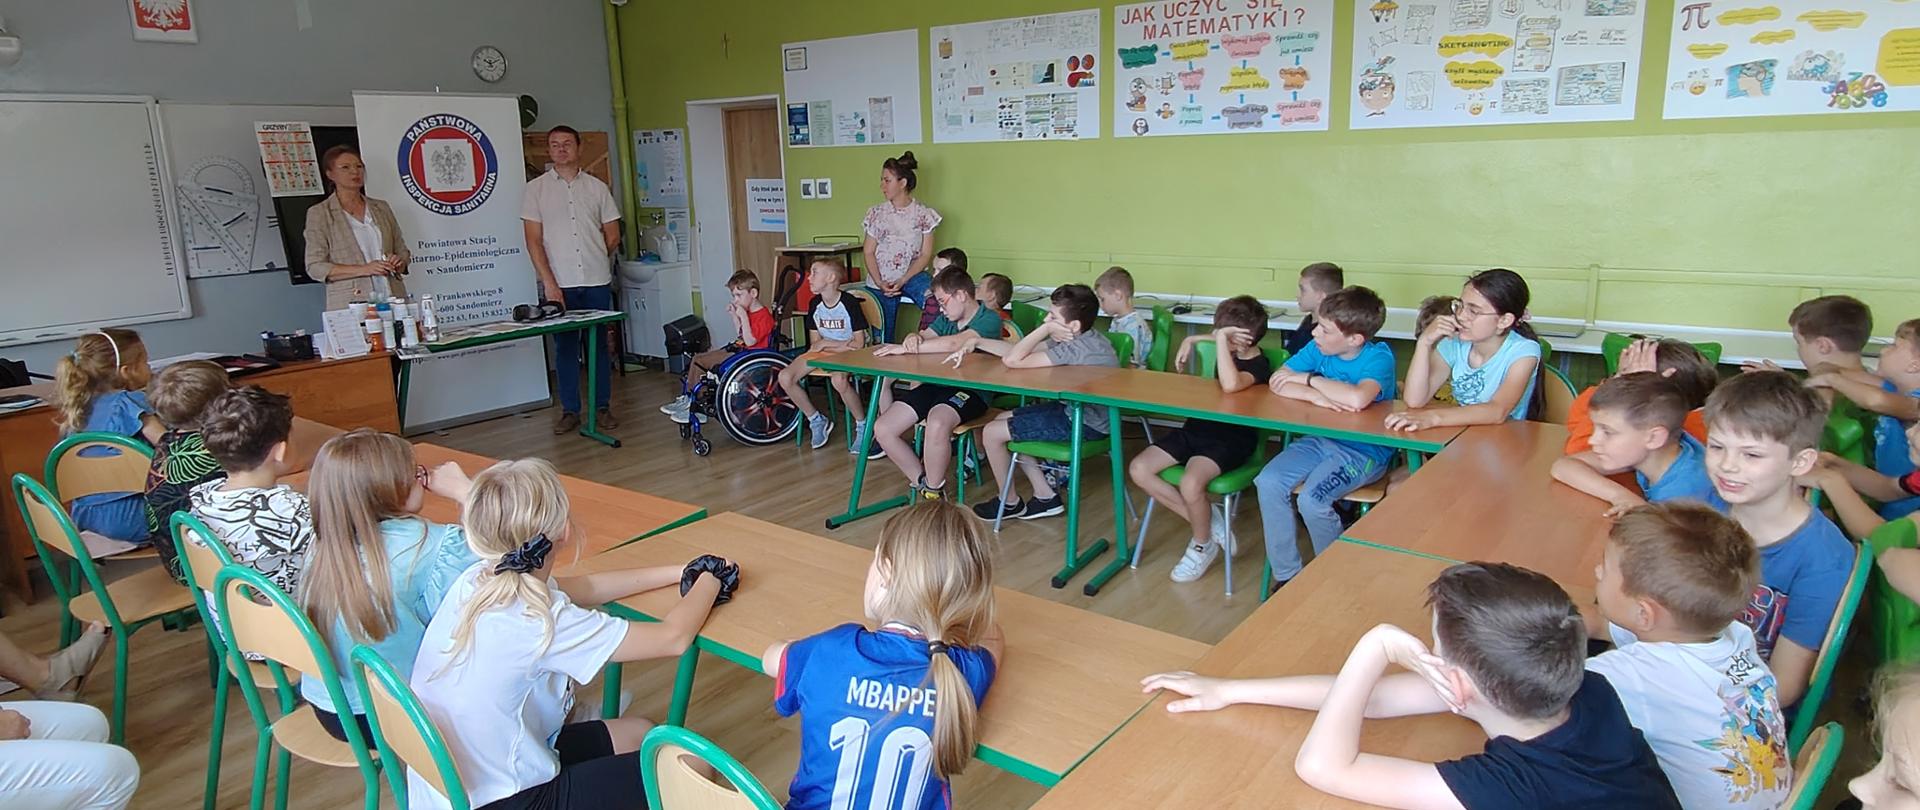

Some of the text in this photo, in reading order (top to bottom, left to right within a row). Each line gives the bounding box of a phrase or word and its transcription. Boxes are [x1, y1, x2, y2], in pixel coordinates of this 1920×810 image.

[1121, 6, 1155, 25] JAK
[407, 115, 483, 142] PAŃSTWOWA
[402, 172, 497, 214] INSPEKCJA SANITARNA
[418, 235, 497, 250] Powiatowa Stacja
[410, 246, 520, 264] itarno-Epidemiologiczna
[437, 262, 495, 275] Sandomierzu
[456, 299, 502, 311] Sandomierz
[822, 319, 842, 329] SKATE
[828, 716, 934, 810] 10
